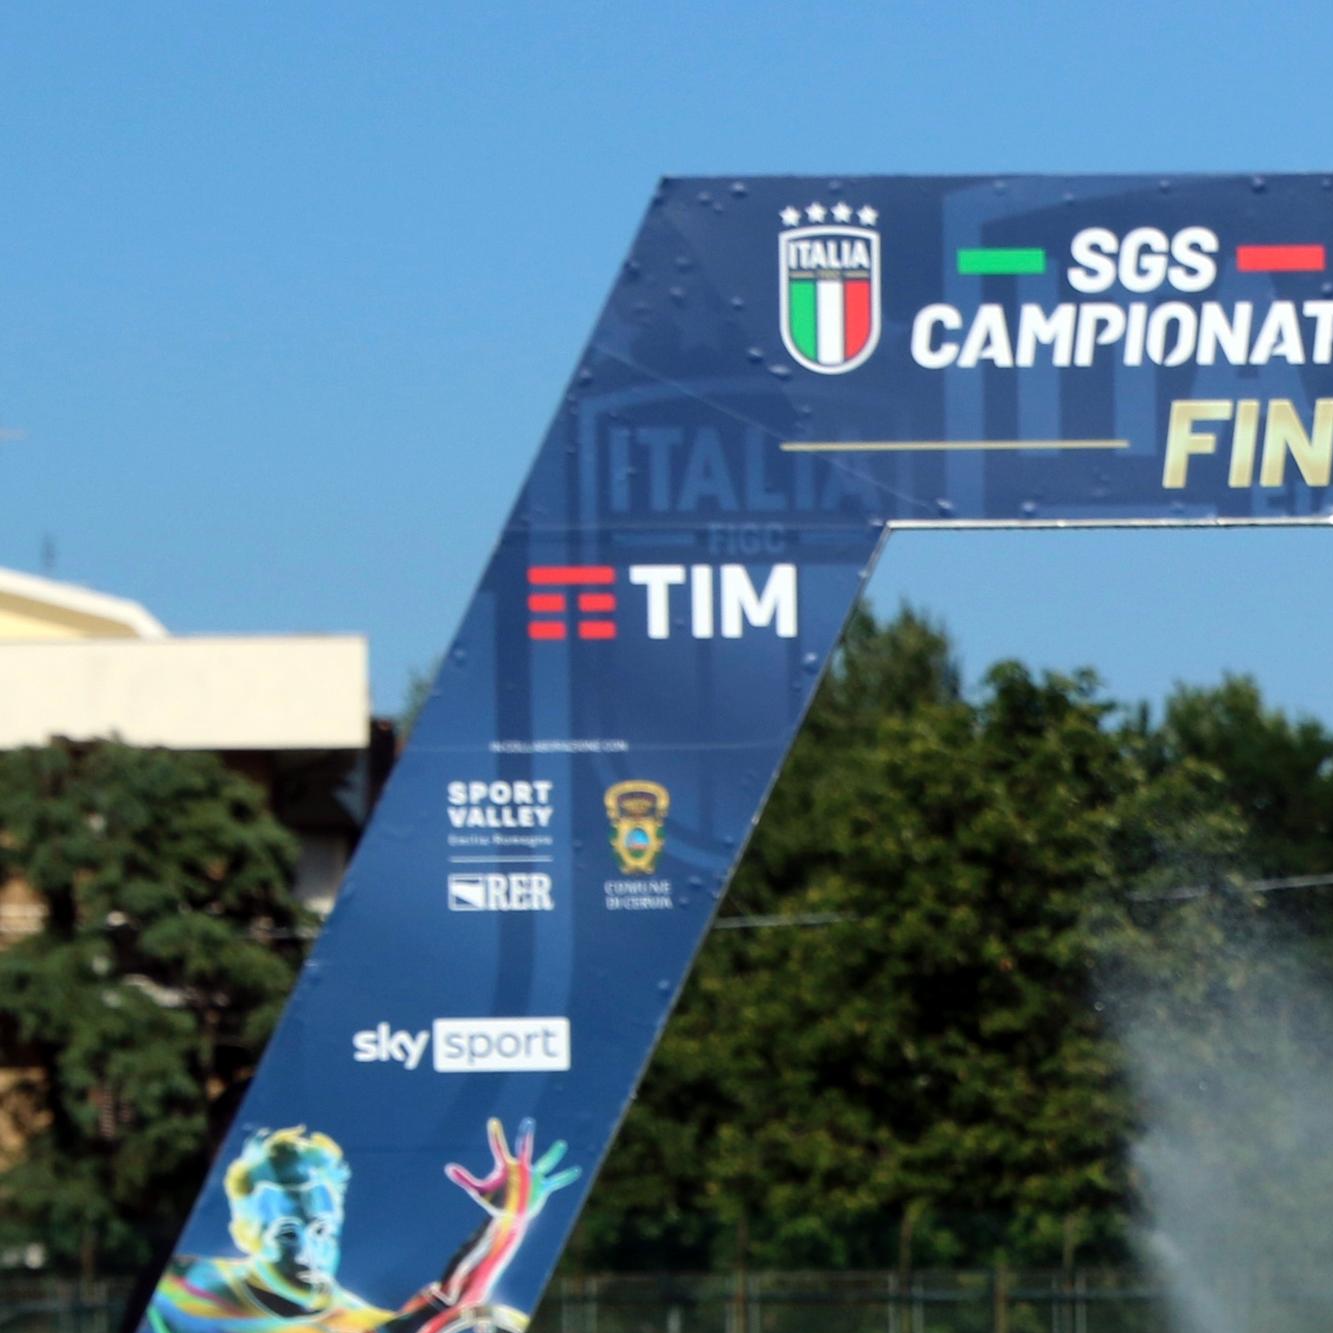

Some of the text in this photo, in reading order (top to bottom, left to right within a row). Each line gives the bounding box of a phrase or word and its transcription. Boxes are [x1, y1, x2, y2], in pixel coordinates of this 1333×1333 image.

[787, 239, 871, 269] ITALIA
[1068, 227, 1219, 293] SGS
[629, 563, 798, 639] TIM
[448, 780, 553, 805] SPORT
[447, 805, 554, 828] VALLEY
[488, 873, 555, 911] RER
[353, 1021, 558, 1070] sky sport
